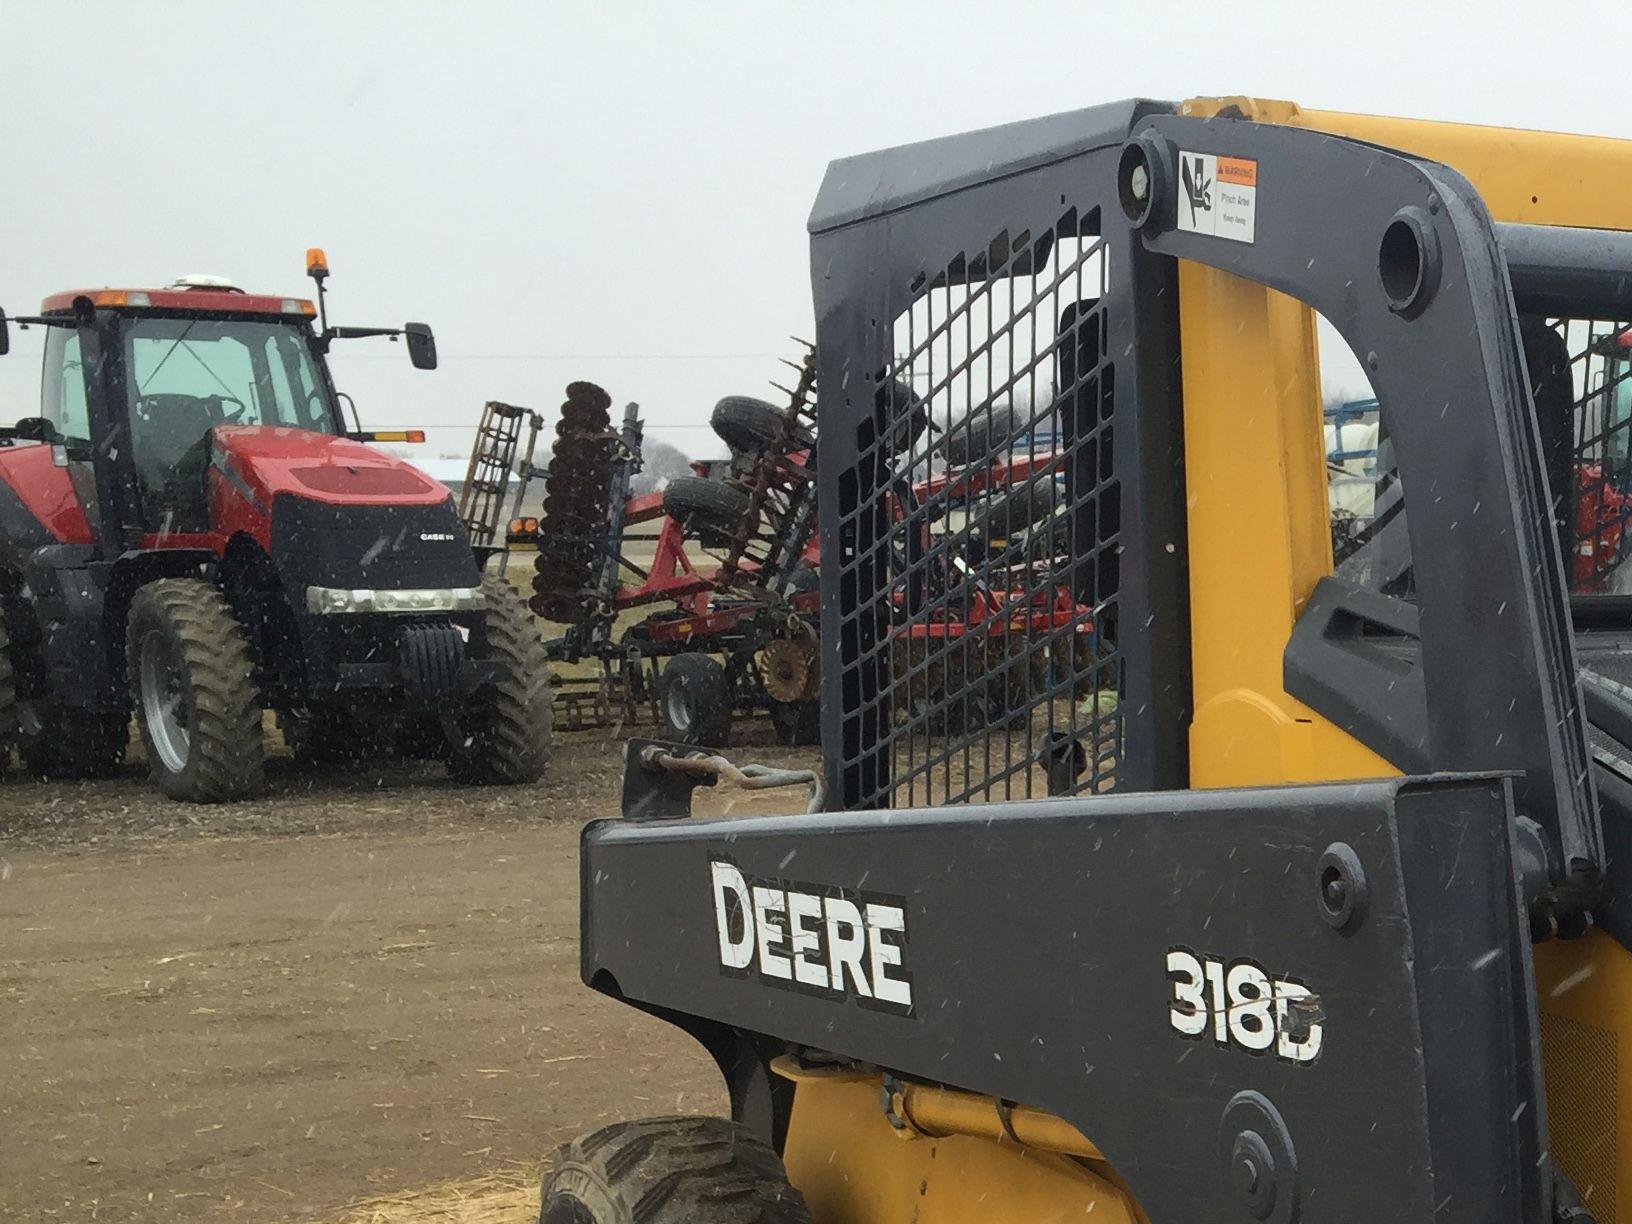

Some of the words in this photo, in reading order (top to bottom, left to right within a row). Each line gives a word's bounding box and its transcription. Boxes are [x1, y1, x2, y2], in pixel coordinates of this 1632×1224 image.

[420, 533, 444, 541] CASE
[711, 861, 912, 1005] DEERE
[1167, 952, 1323, 1060] 318D
